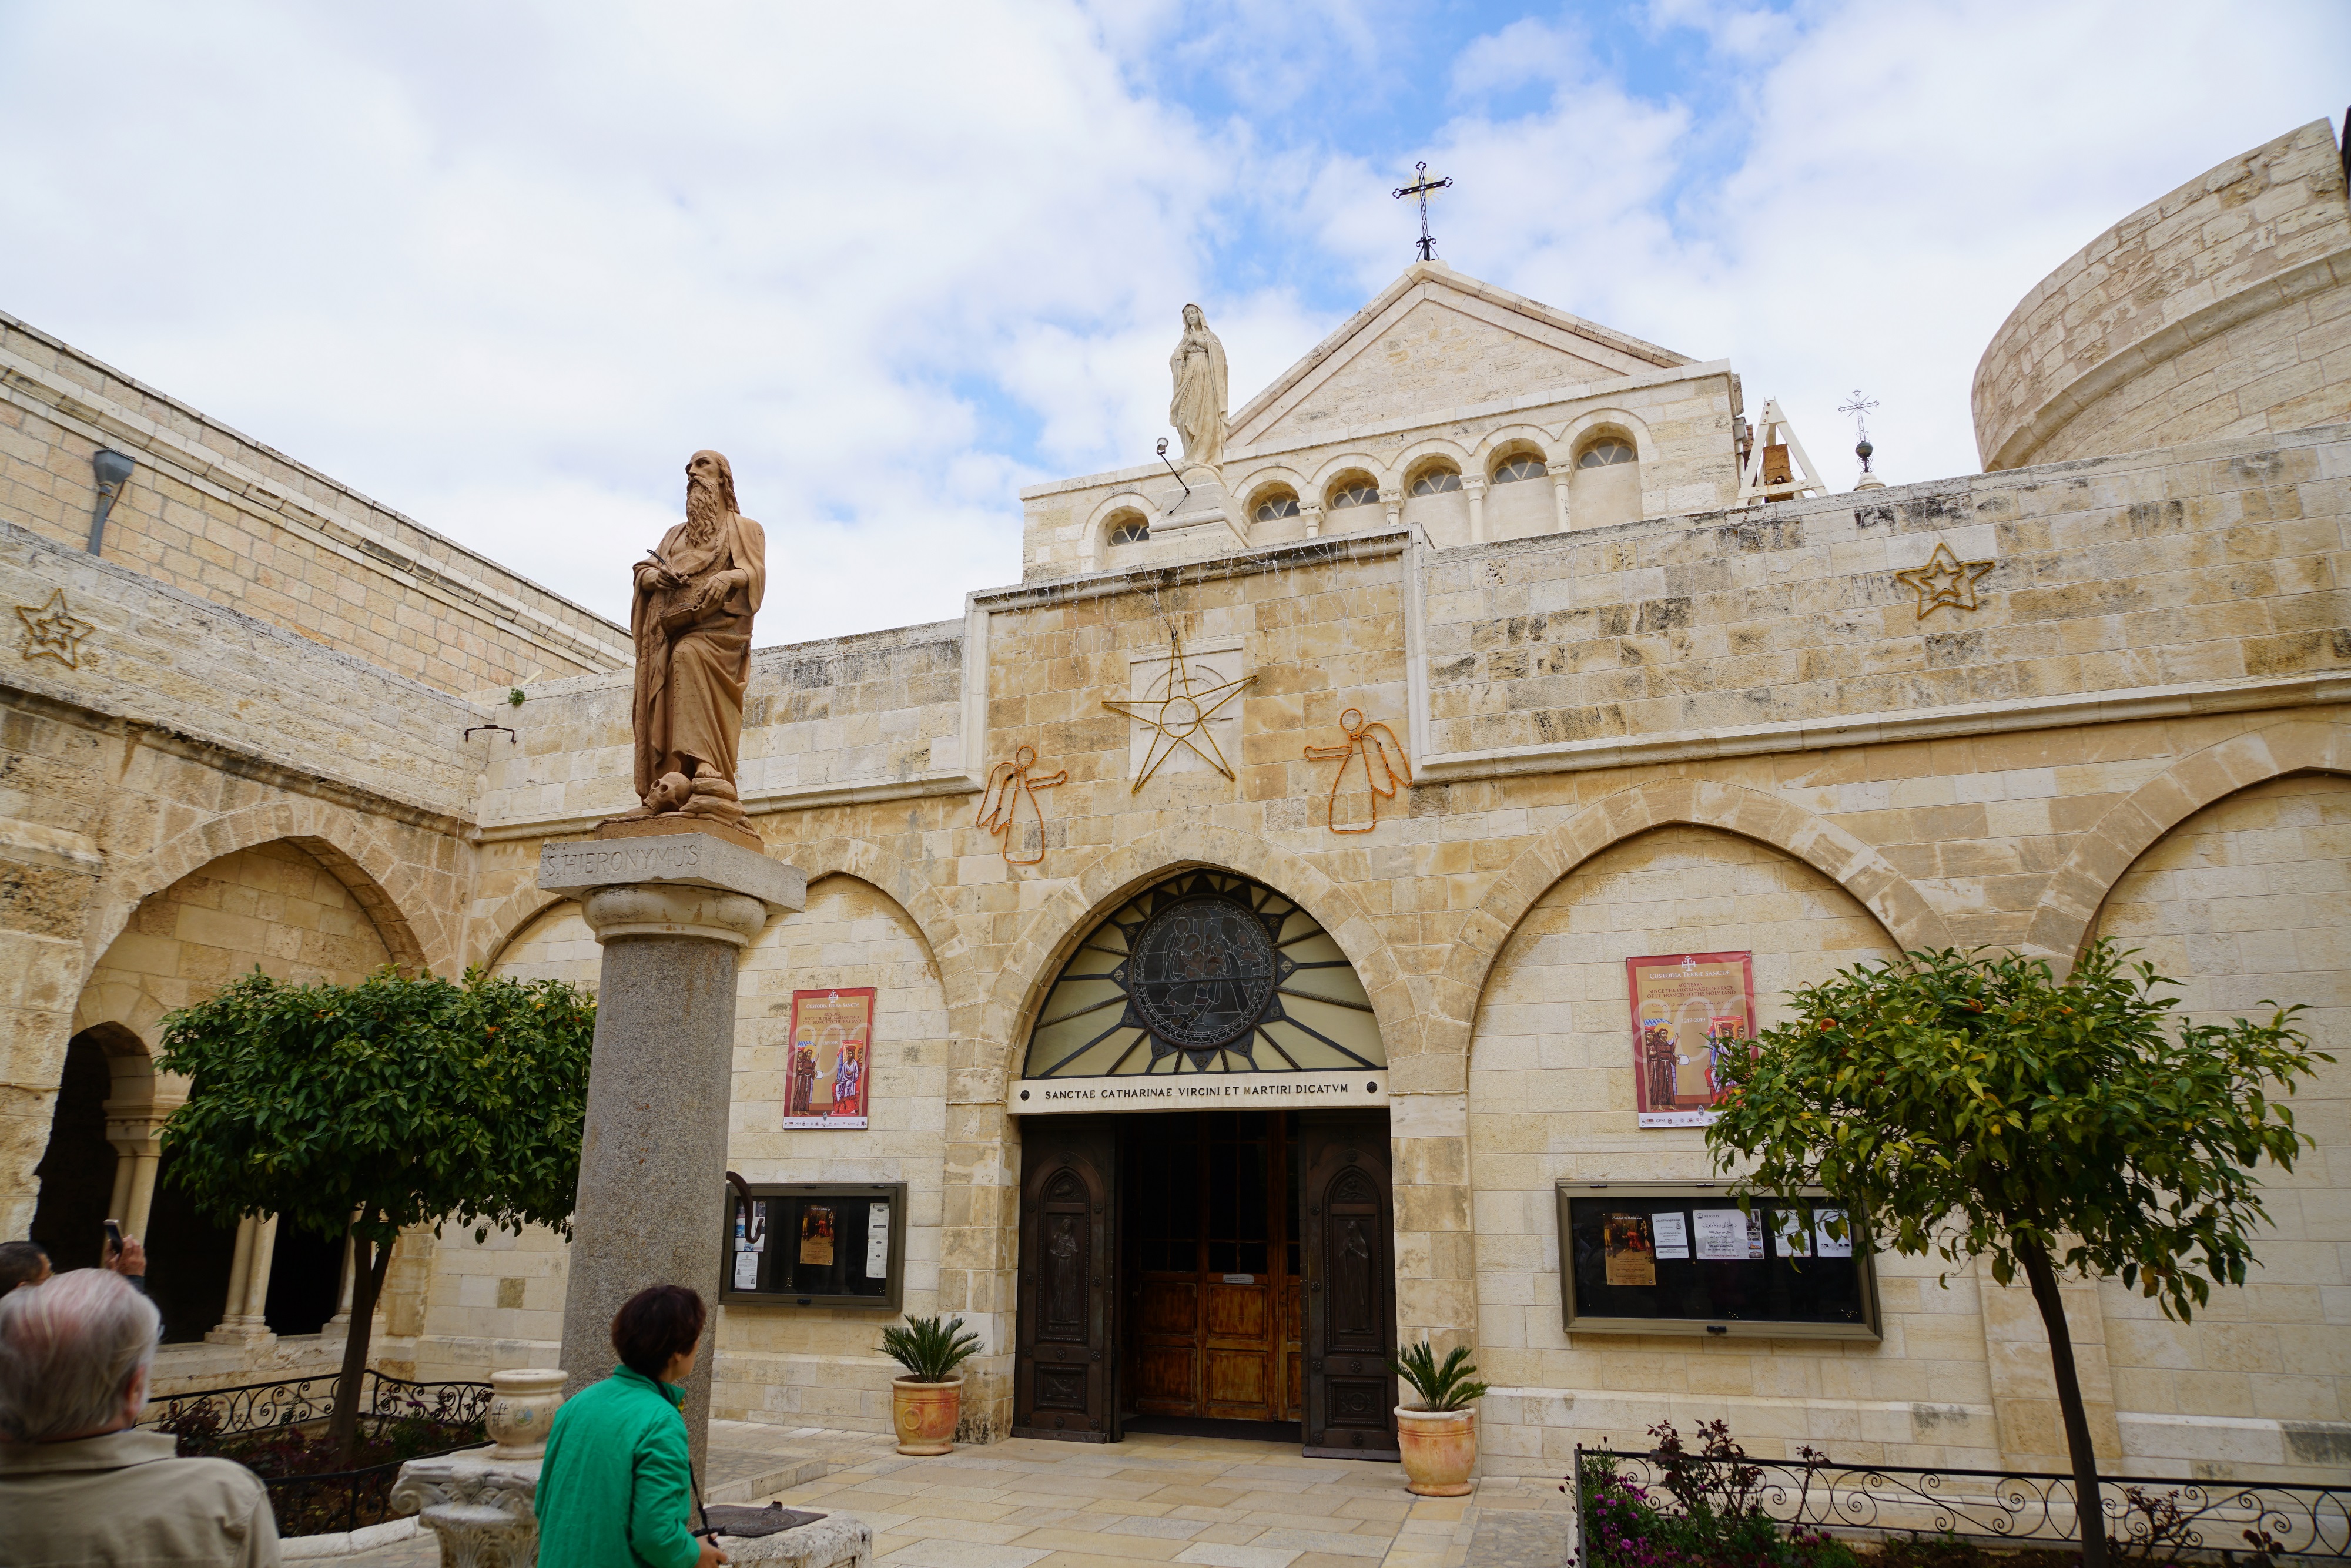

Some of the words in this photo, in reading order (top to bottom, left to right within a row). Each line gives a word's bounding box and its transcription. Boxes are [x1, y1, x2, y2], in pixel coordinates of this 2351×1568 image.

[562, 845, 699, 876] HIERONYMUS
[1044, 1090, 1096, 1099] SANCTAE
[1101, 1088, 1173, 1098] CATHARINAE
[1178, 1087, 1220, 1097] VIRGINI
[1224, 1087, 1240, 1095] ET
[1244, 1085, 1291, 1095] MARTIRI
[1295, 1084, 1348, 1094] DICATVM
